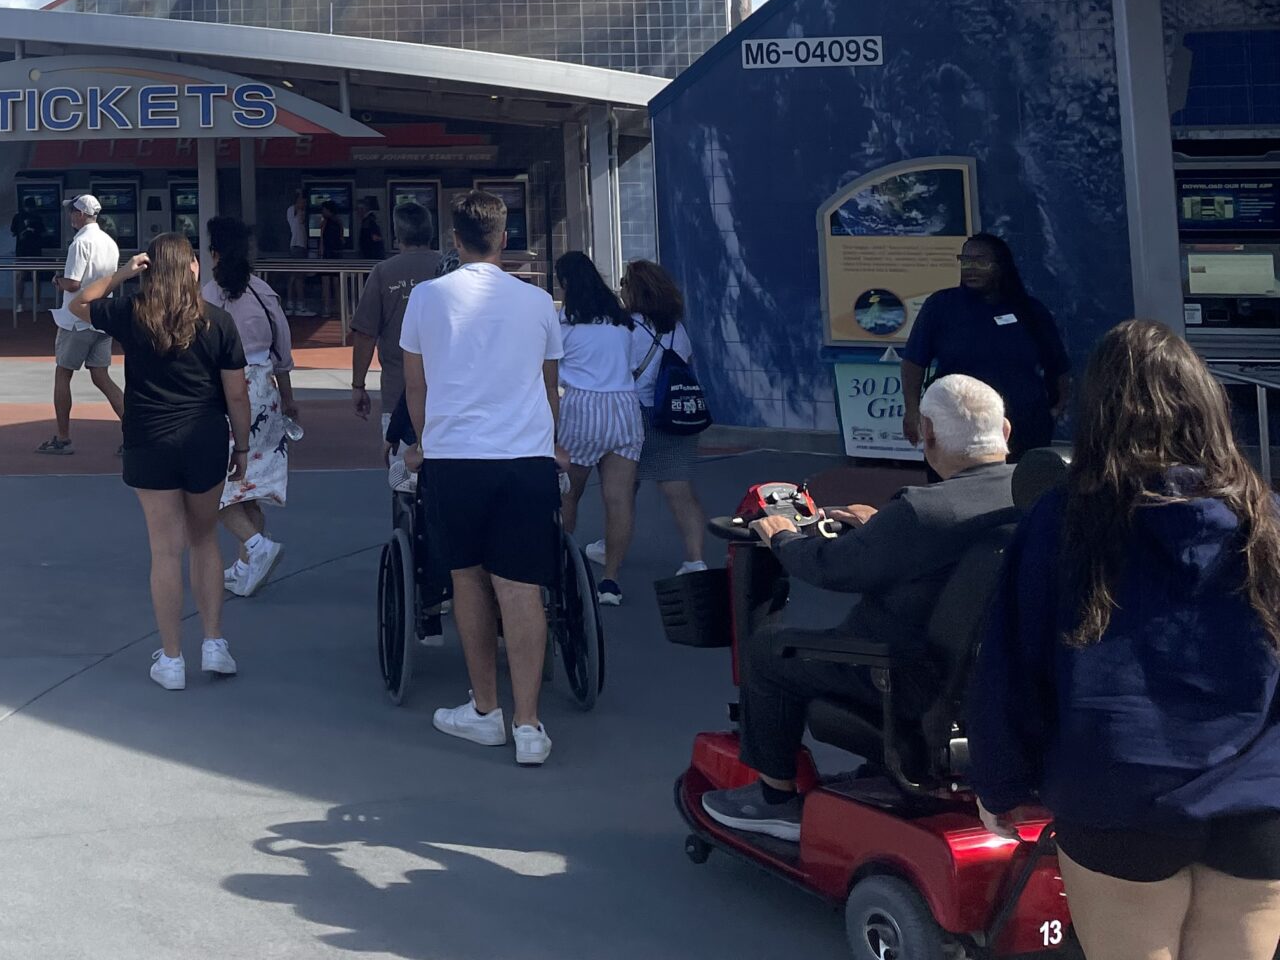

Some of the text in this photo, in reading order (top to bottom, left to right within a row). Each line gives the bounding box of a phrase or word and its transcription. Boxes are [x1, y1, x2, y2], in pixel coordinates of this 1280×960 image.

[745, 39, 879, 65] M6-0409S
[381, 153, 426, 161] JOURNEY
[428, 153, 464, 161] STARTS
[848, 378, 876, 398] 30
[1040, 920, 1062, 946] 13
